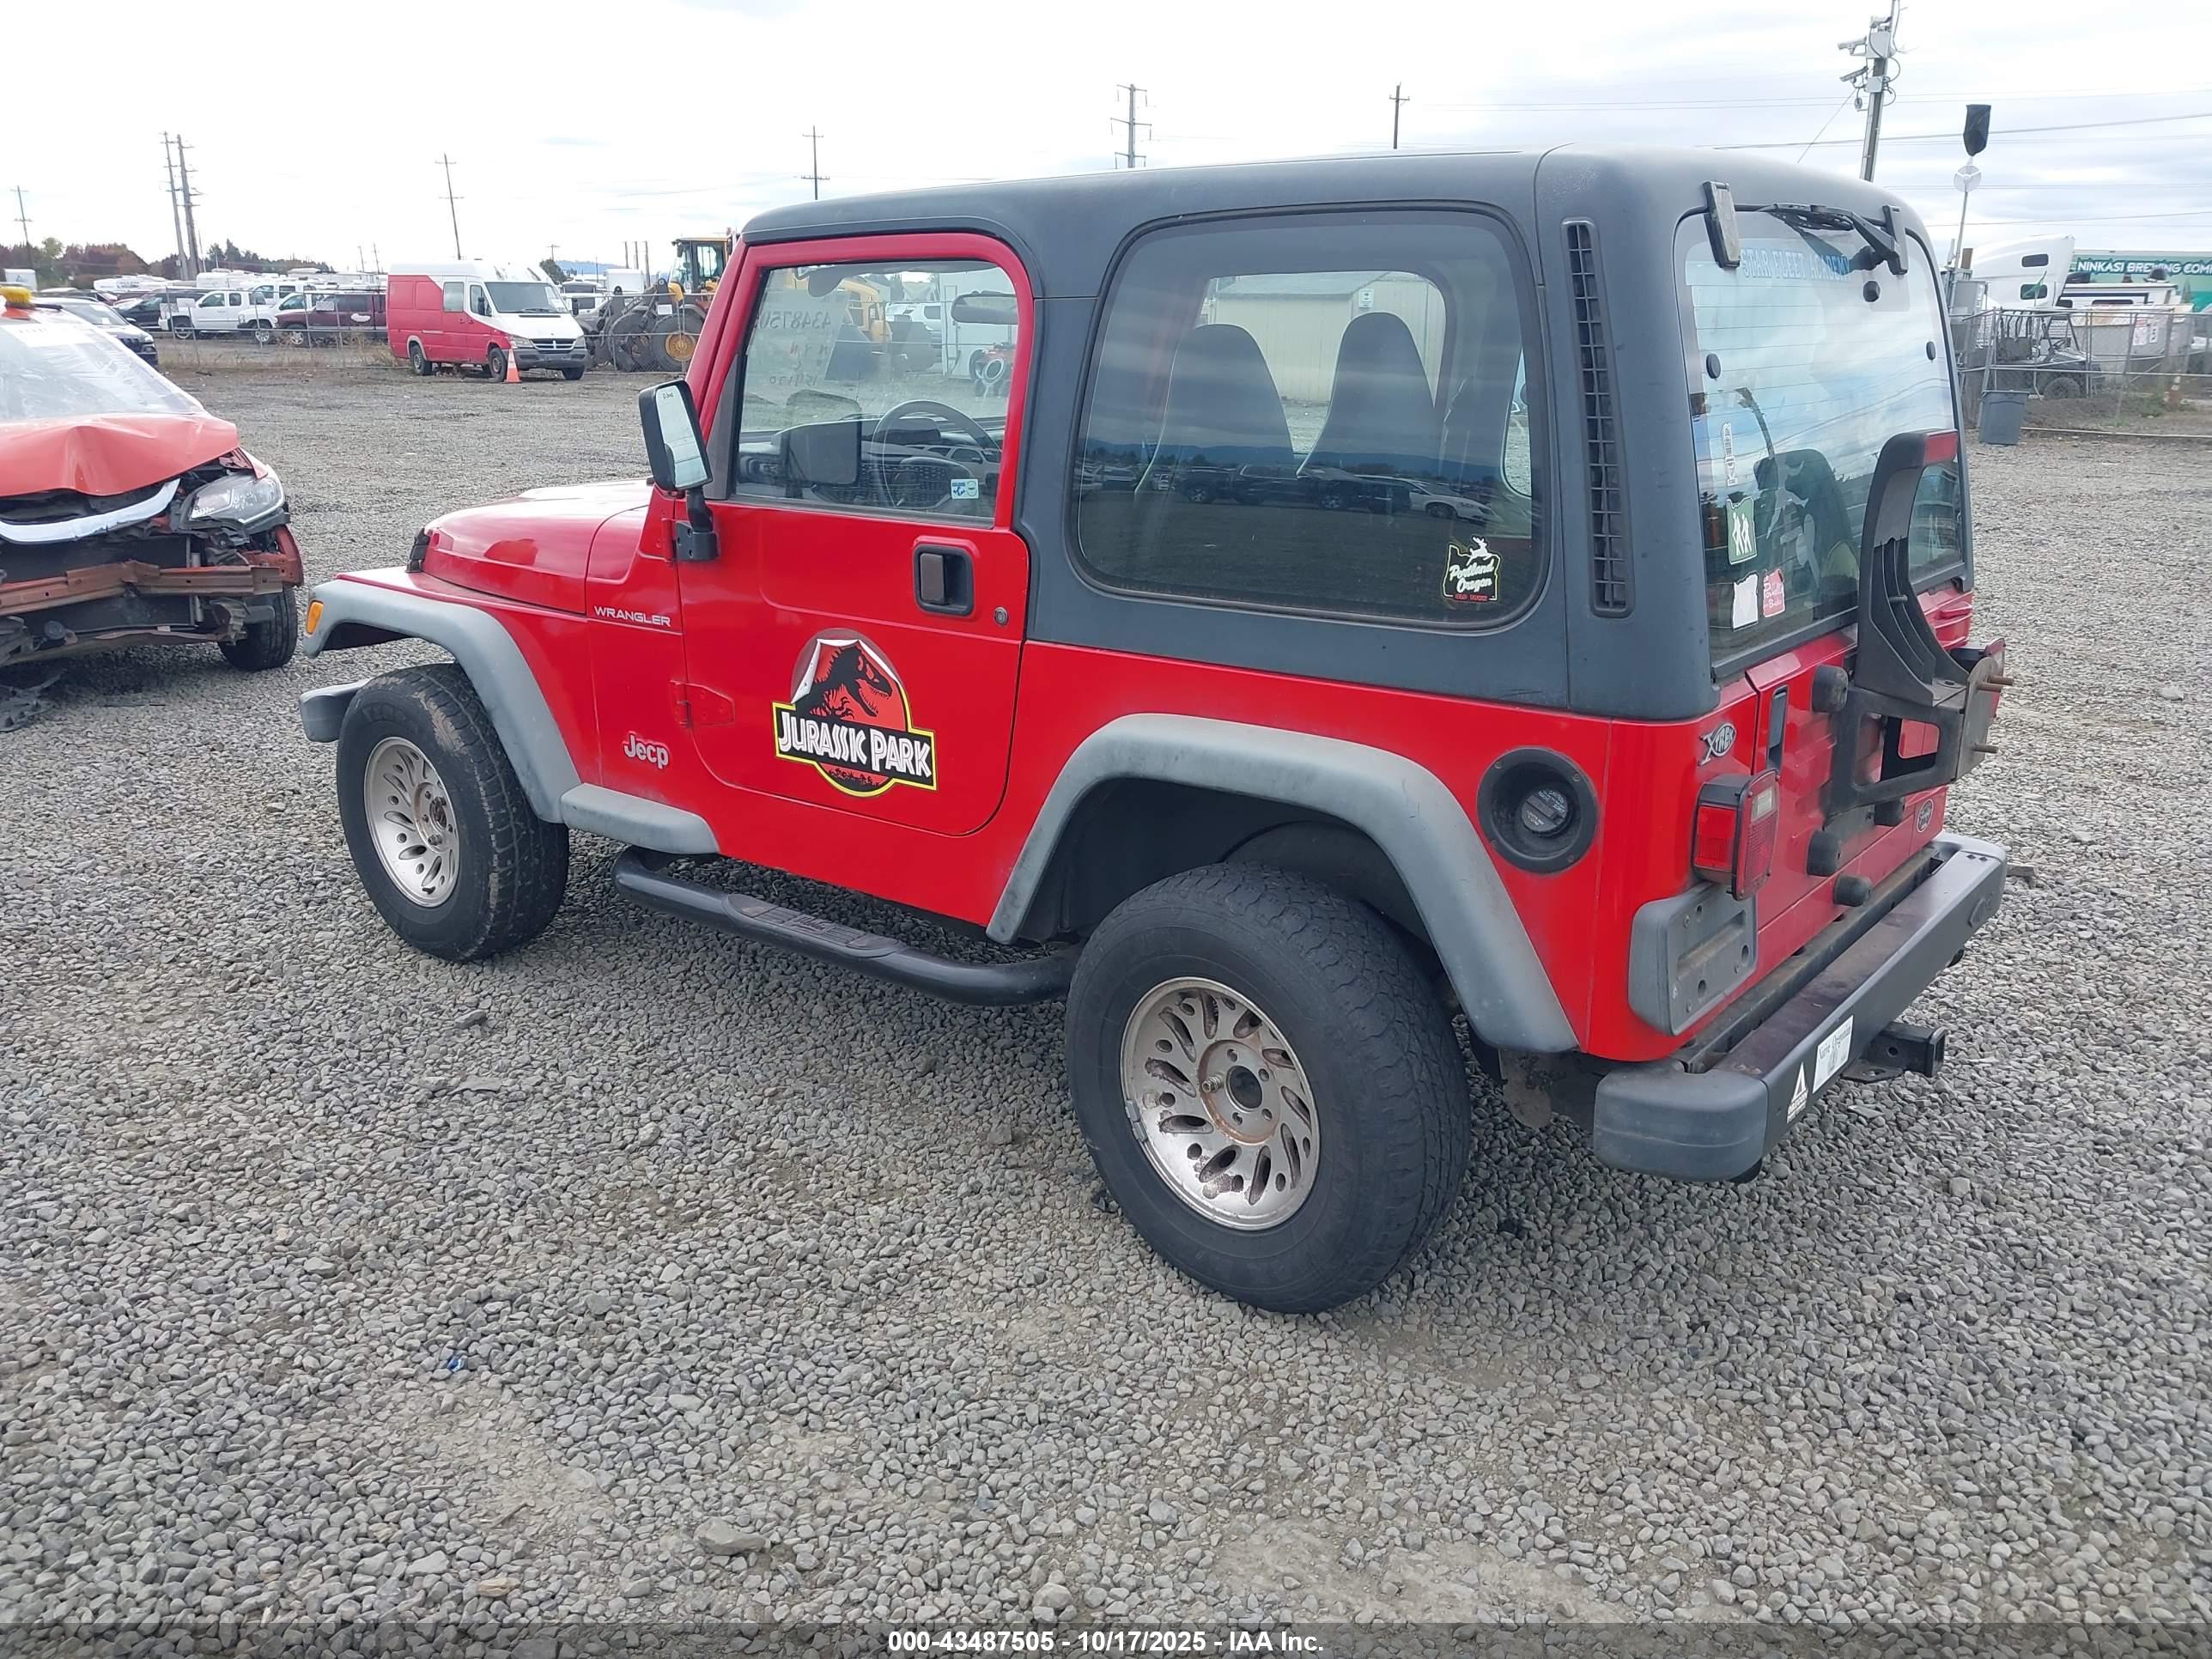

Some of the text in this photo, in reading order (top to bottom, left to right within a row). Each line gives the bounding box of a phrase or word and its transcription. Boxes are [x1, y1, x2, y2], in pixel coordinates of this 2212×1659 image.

[1741, 247, 1772, 278] STAR
[2077, 260, 2124, 273] NINKASI
[1449, 558, 1495, 581] Portland
[1456, 577, 1493, 593] Oregon
[593, 605, 672, 627] WRANGLER
[623, 734, 670, 769] Jeep
[777, 710, 933, 779] JURASSIC PARK
